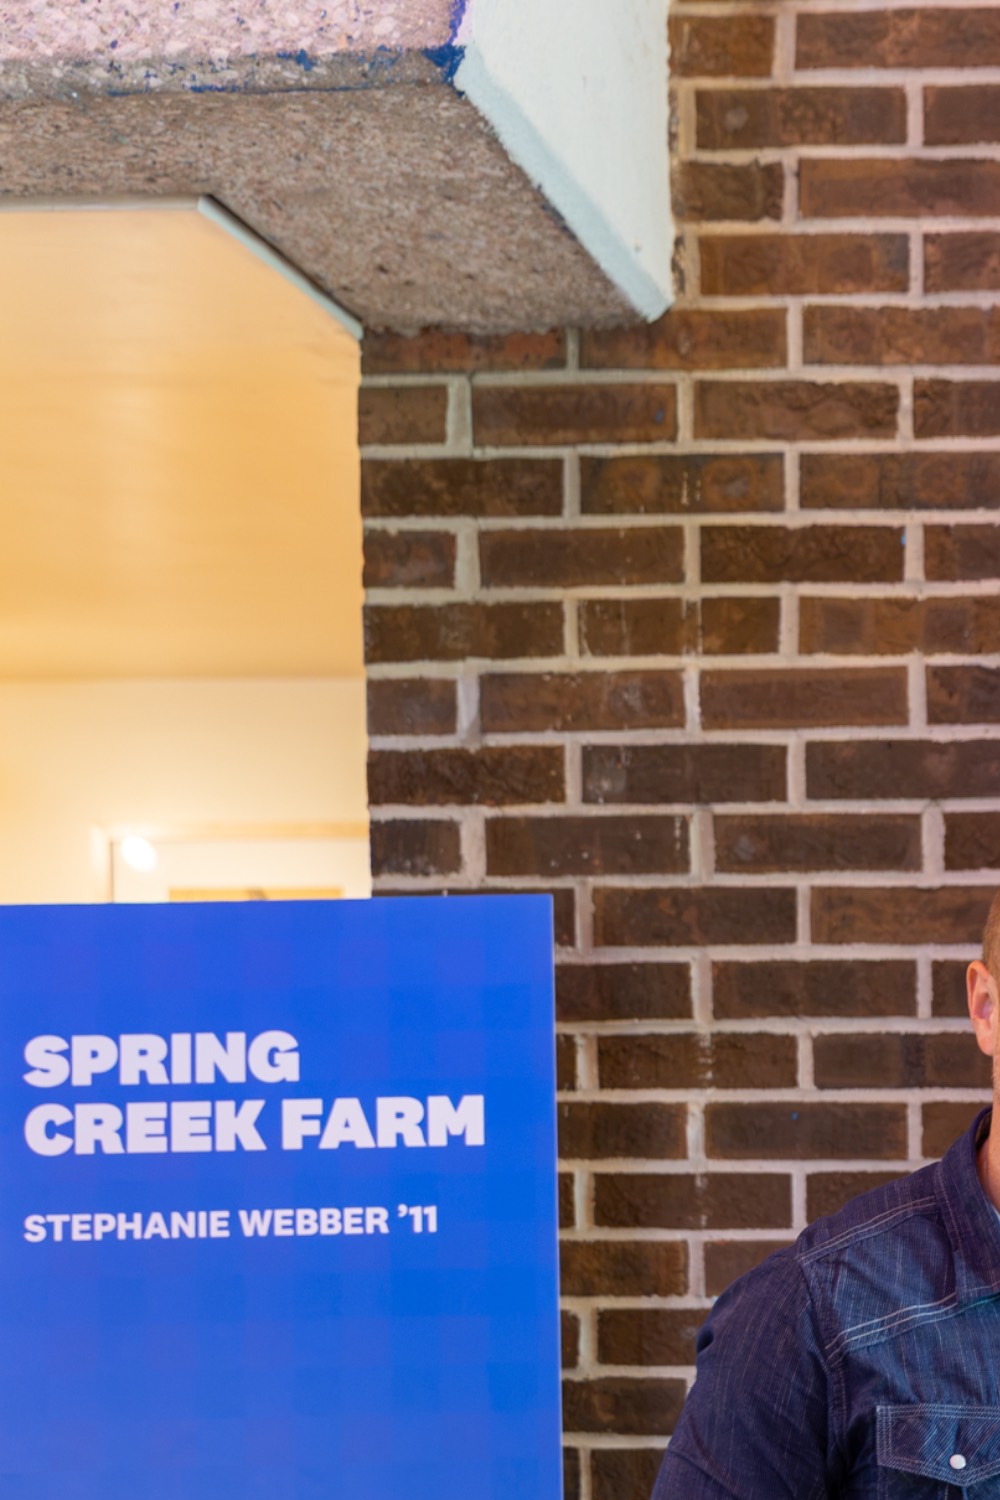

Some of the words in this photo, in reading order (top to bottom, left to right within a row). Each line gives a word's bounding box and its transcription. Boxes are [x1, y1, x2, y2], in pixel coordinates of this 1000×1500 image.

[23, 1030, 301, 1088] SPRING
[24, 1099, 267, 1157] CREEK
[281, 1094, 486, 1150] FARM
[23, 1210, 231, 1243] STEPHANIE
[239, 1206, 390, 1238] WEBBER
